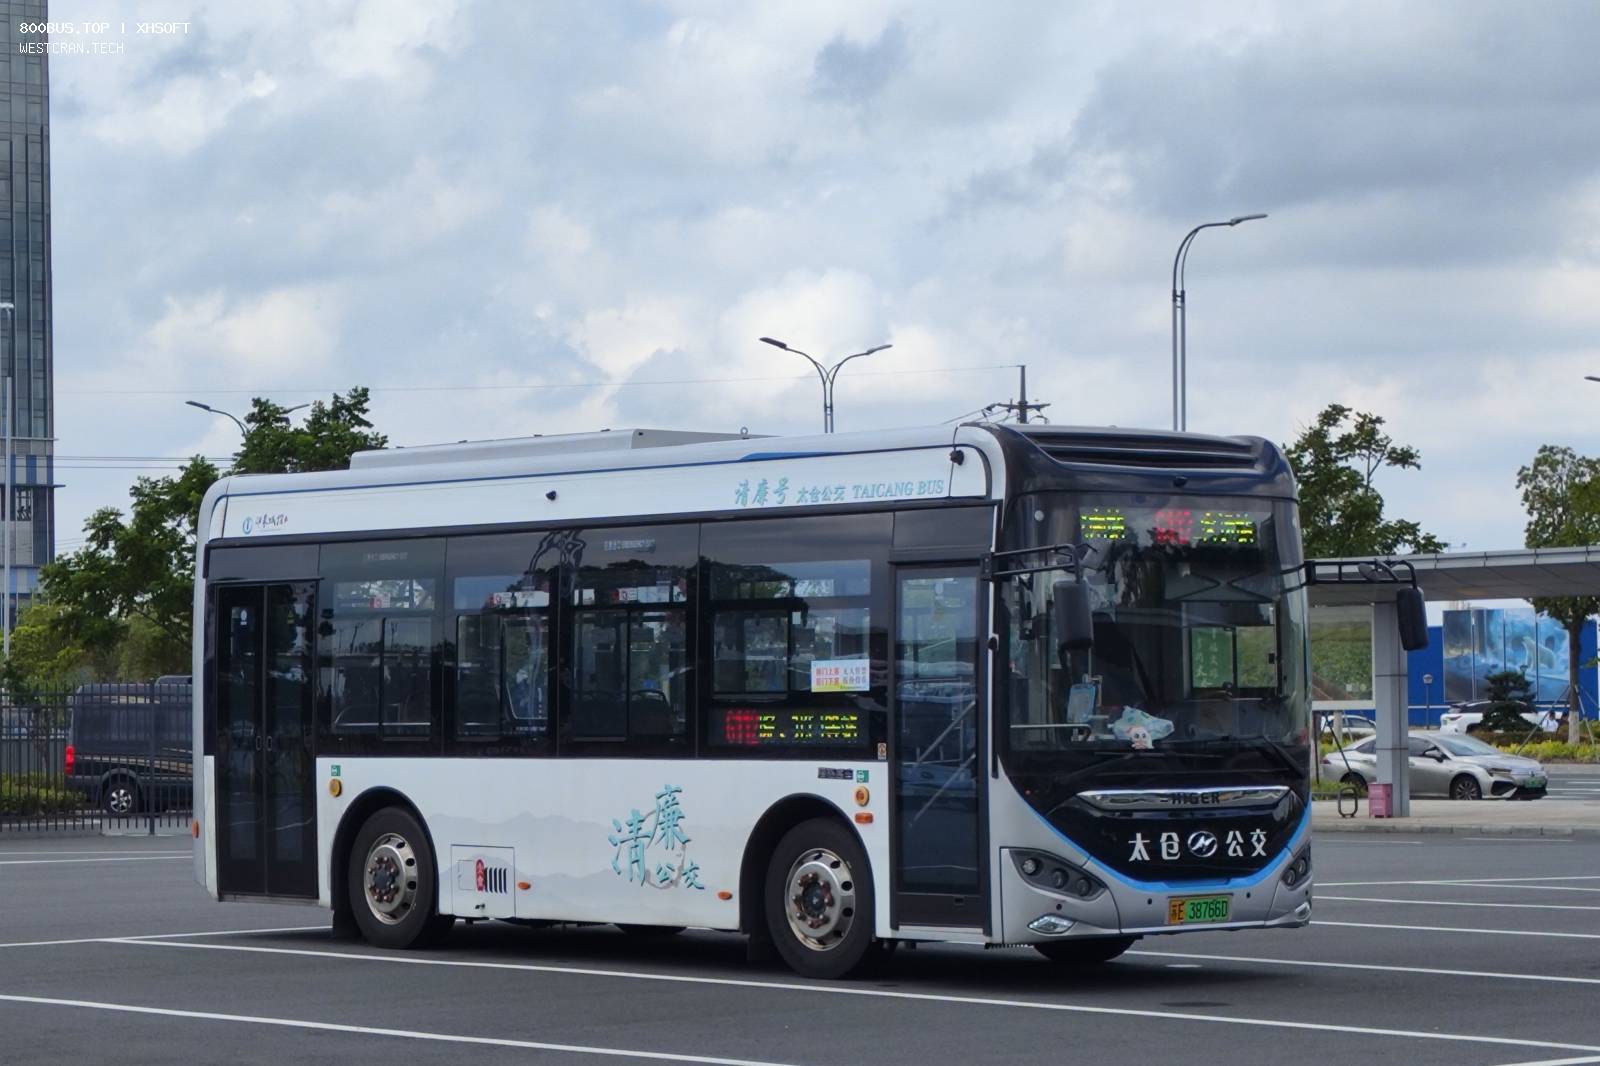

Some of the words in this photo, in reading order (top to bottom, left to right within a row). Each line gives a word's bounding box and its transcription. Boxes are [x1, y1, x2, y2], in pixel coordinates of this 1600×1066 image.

[852, 481, 914, 500] TAICANG
[917, 479, 945, 496] BUS
[1171, 792, 1220, 805] HIGER
[1128, 832, 1181, 862] 太仓
[1225, 828, 1268, 857] 公交
